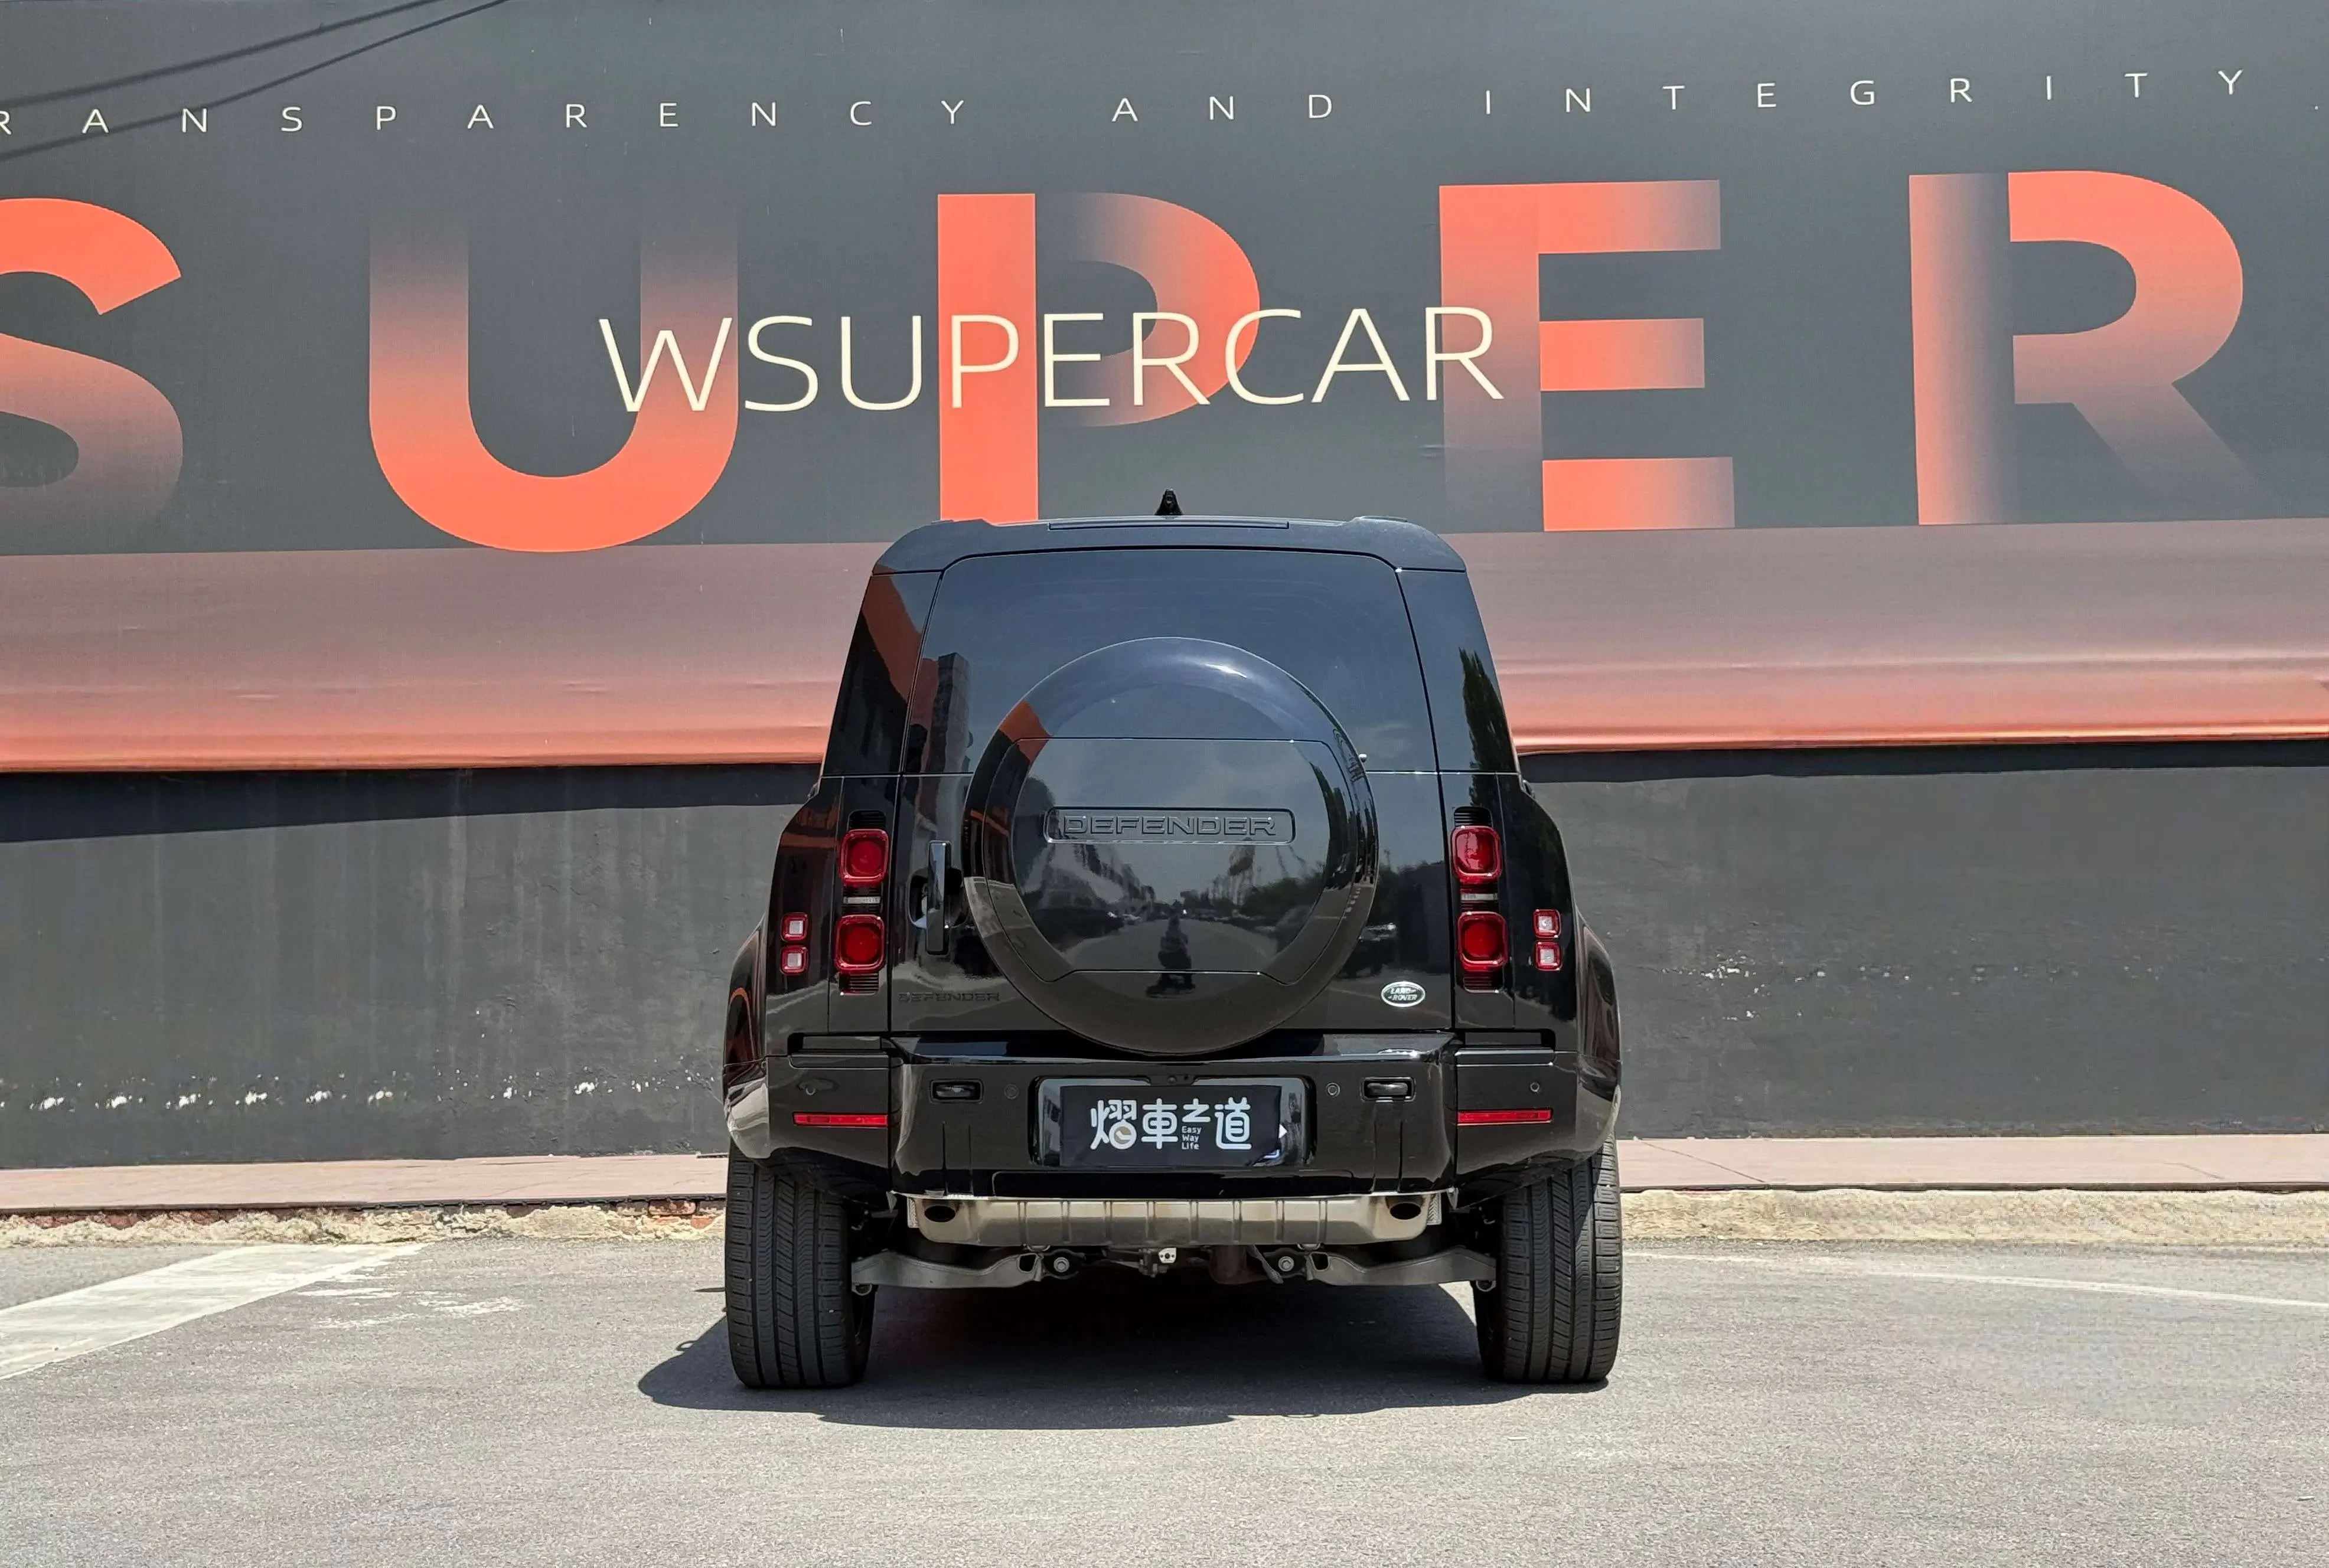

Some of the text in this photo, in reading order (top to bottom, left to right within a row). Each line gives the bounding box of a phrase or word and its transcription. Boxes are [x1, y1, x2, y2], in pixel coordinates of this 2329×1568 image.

[1111, 93, 1333, 122] AND
[1485, 68, 2243, 115] INTEGRITY
[598, 306, 1505, 413] WSUPERCAR
[1063, 814, 1276, 837] DEFENDER
[898, 992, 1000, 1002] DEFENDER
[1182, 1125, 1202, 1135] Easy
[1182, 1134, 1199, 1143] Way
[1182, 1142, 1200, 1150] Life
